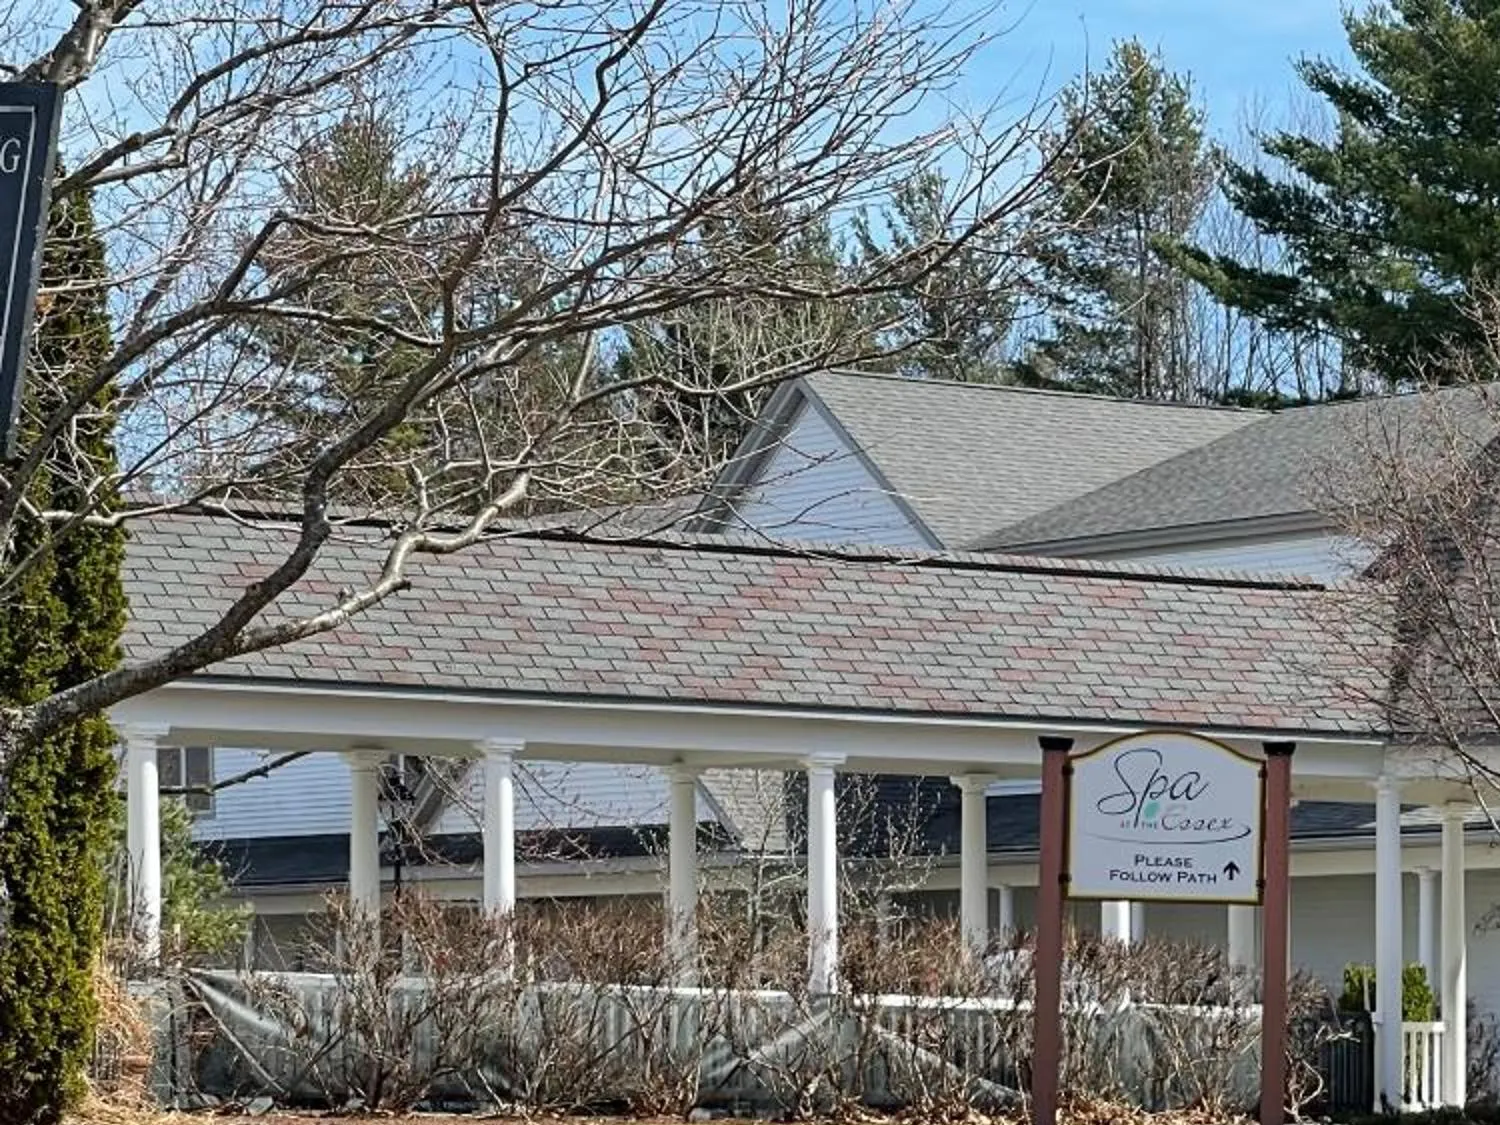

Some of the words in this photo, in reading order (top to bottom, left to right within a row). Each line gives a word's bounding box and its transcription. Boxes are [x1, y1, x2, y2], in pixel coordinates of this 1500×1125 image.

[1097, 748, 1208, 829] Spa
[1134, 854, 1193, 868] PLEASE
[1109, 869, 1172, 883] FOLLOW
[1177, 871, 1217, 884] PATH
